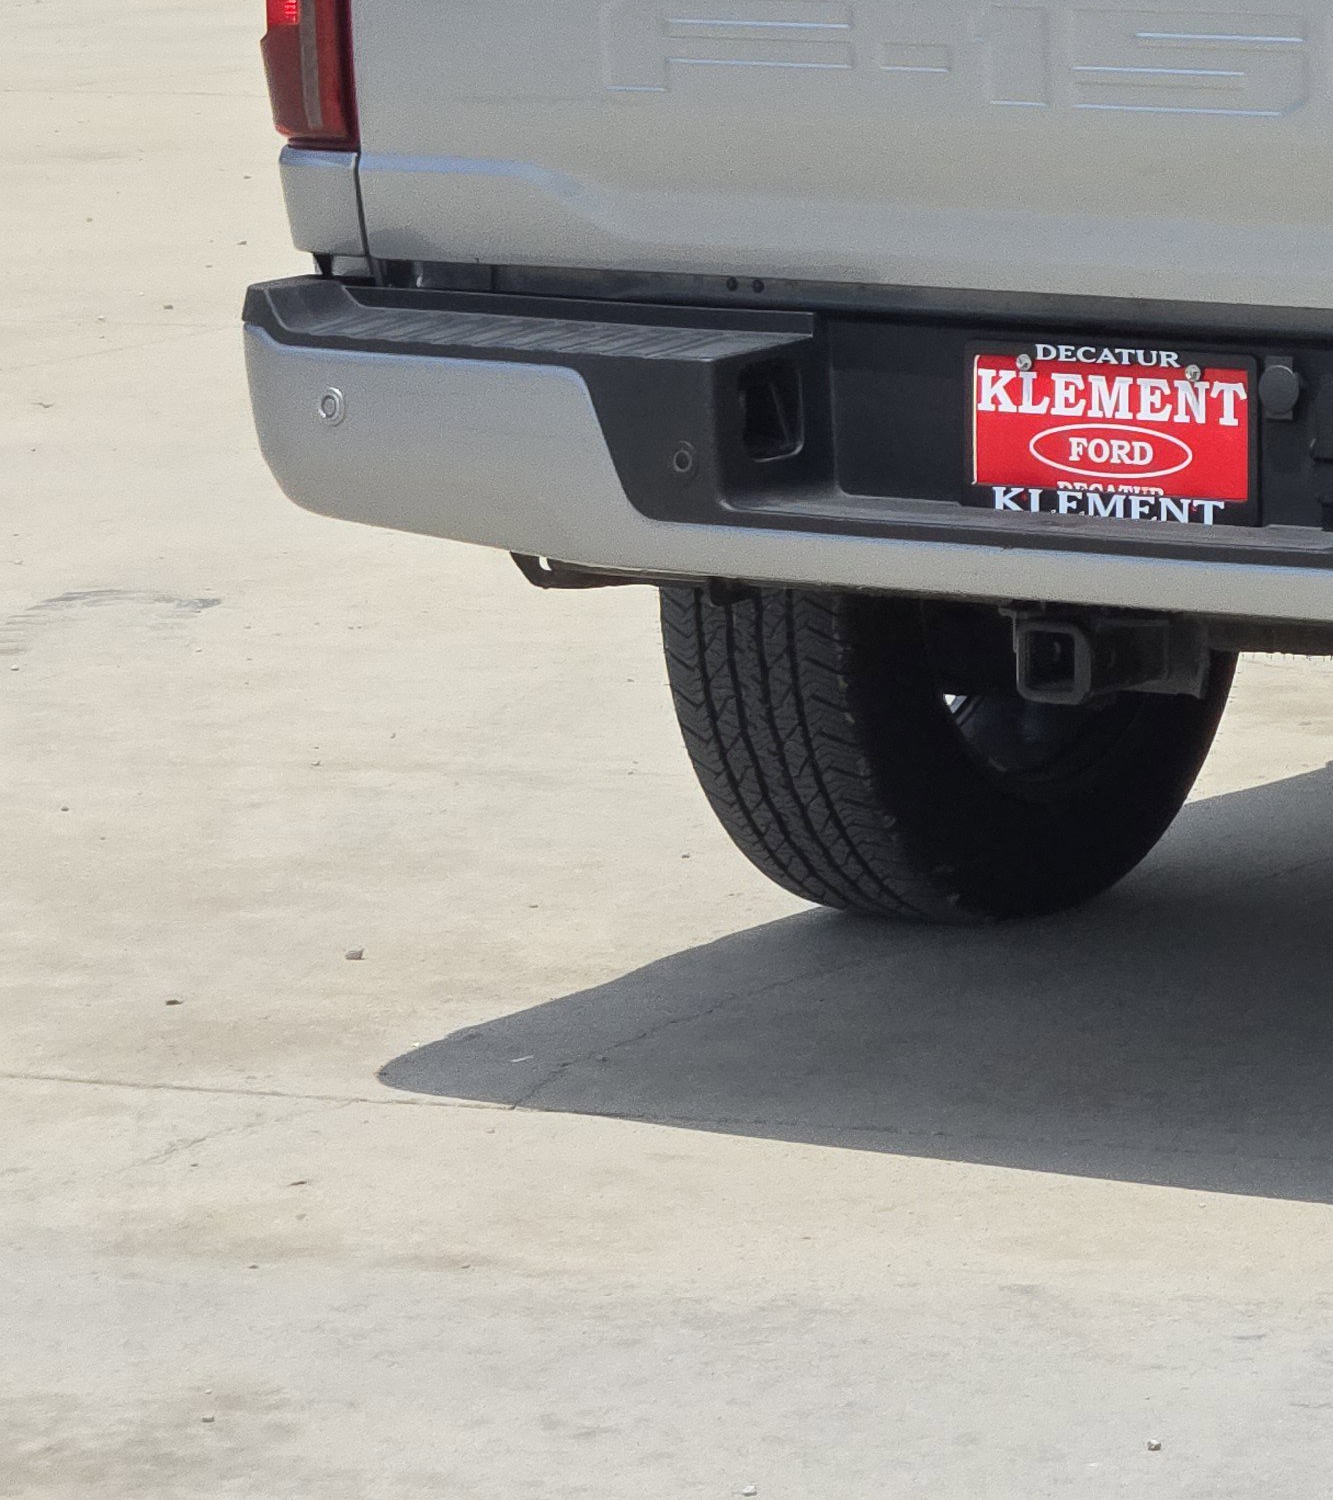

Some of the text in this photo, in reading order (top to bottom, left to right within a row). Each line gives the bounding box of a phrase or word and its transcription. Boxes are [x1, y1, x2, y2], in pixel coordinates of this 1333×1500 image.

[1034, 343, 1181, 368] DECATUR
[976, 367, 1248, 426] KLEMENT
[1068, 436, 1154, 466] FORD
